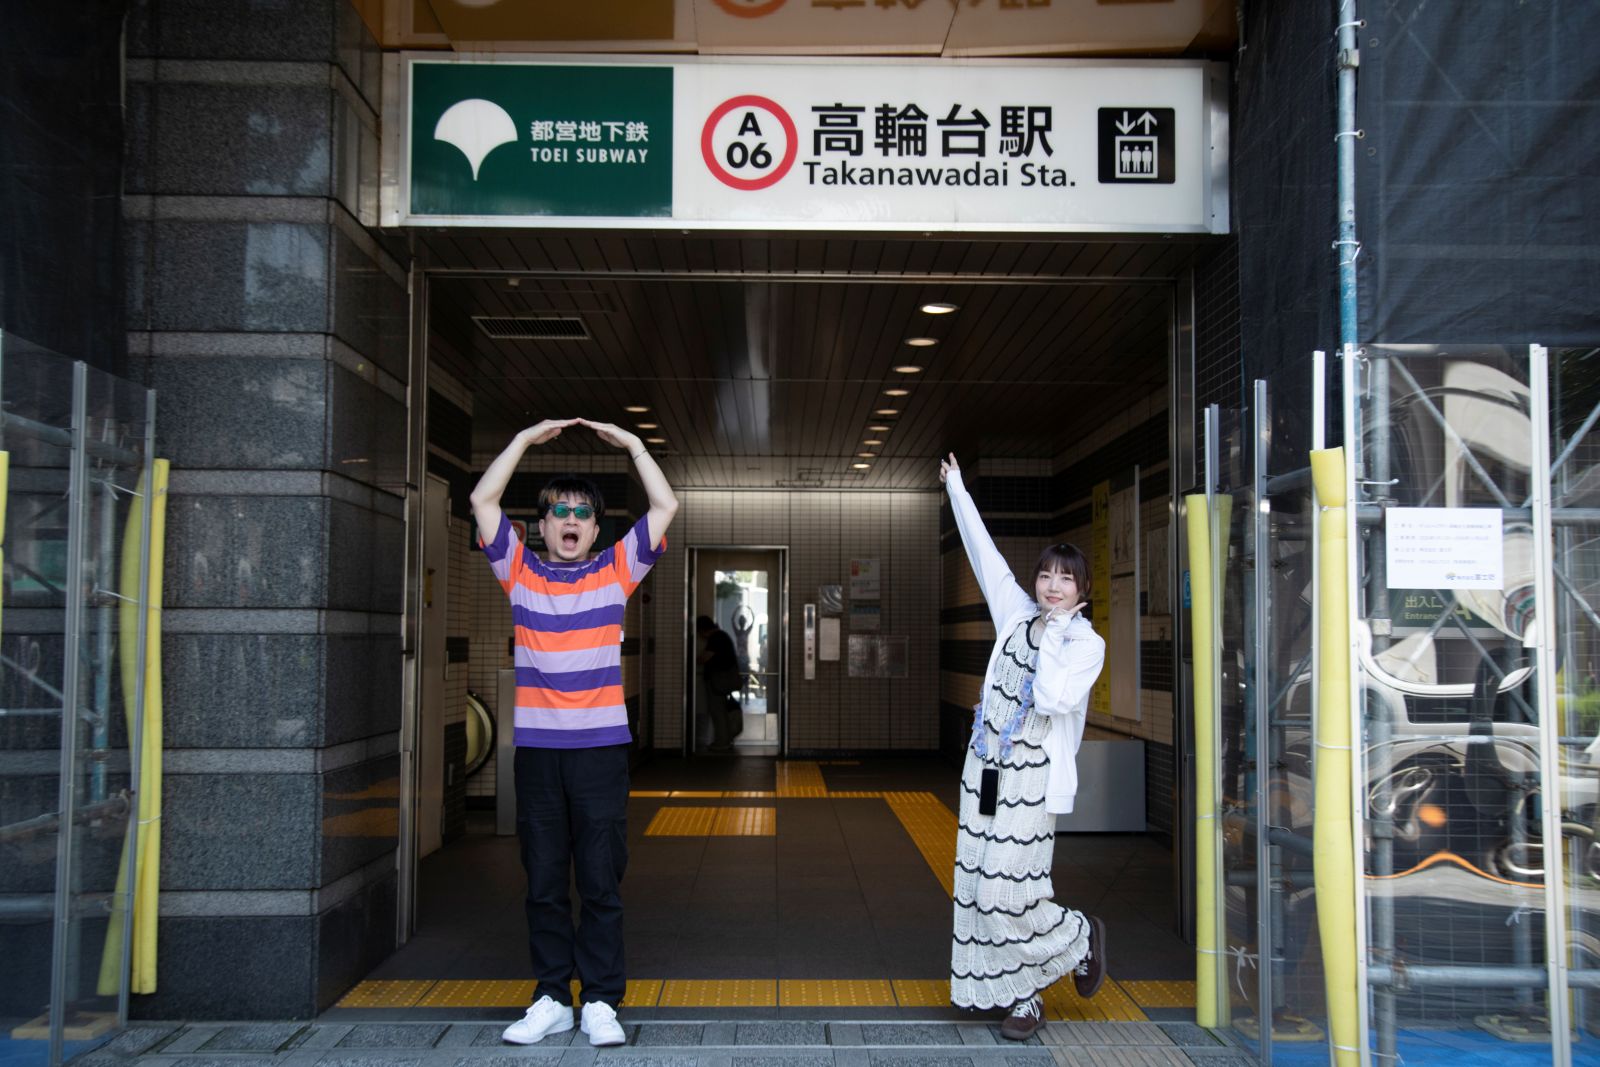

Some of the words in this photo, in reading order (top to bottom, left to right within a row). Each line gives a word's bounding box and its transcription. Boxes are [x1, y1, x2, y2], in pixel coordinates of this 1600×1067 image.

[530, 120, 649, 142] 都営地下鉄
[737, 111, 763, 137] A
[811, 102, 1055, 158] 高輪台駅
[530, 148, 568, 163] TOEI
[576, 148, 649, 164] SUBWAY
[726, 141, 773, 169] 06
[803, 160, 1008, 186] Takanawadai
[1020, 162, 1076, 187] Sta.
